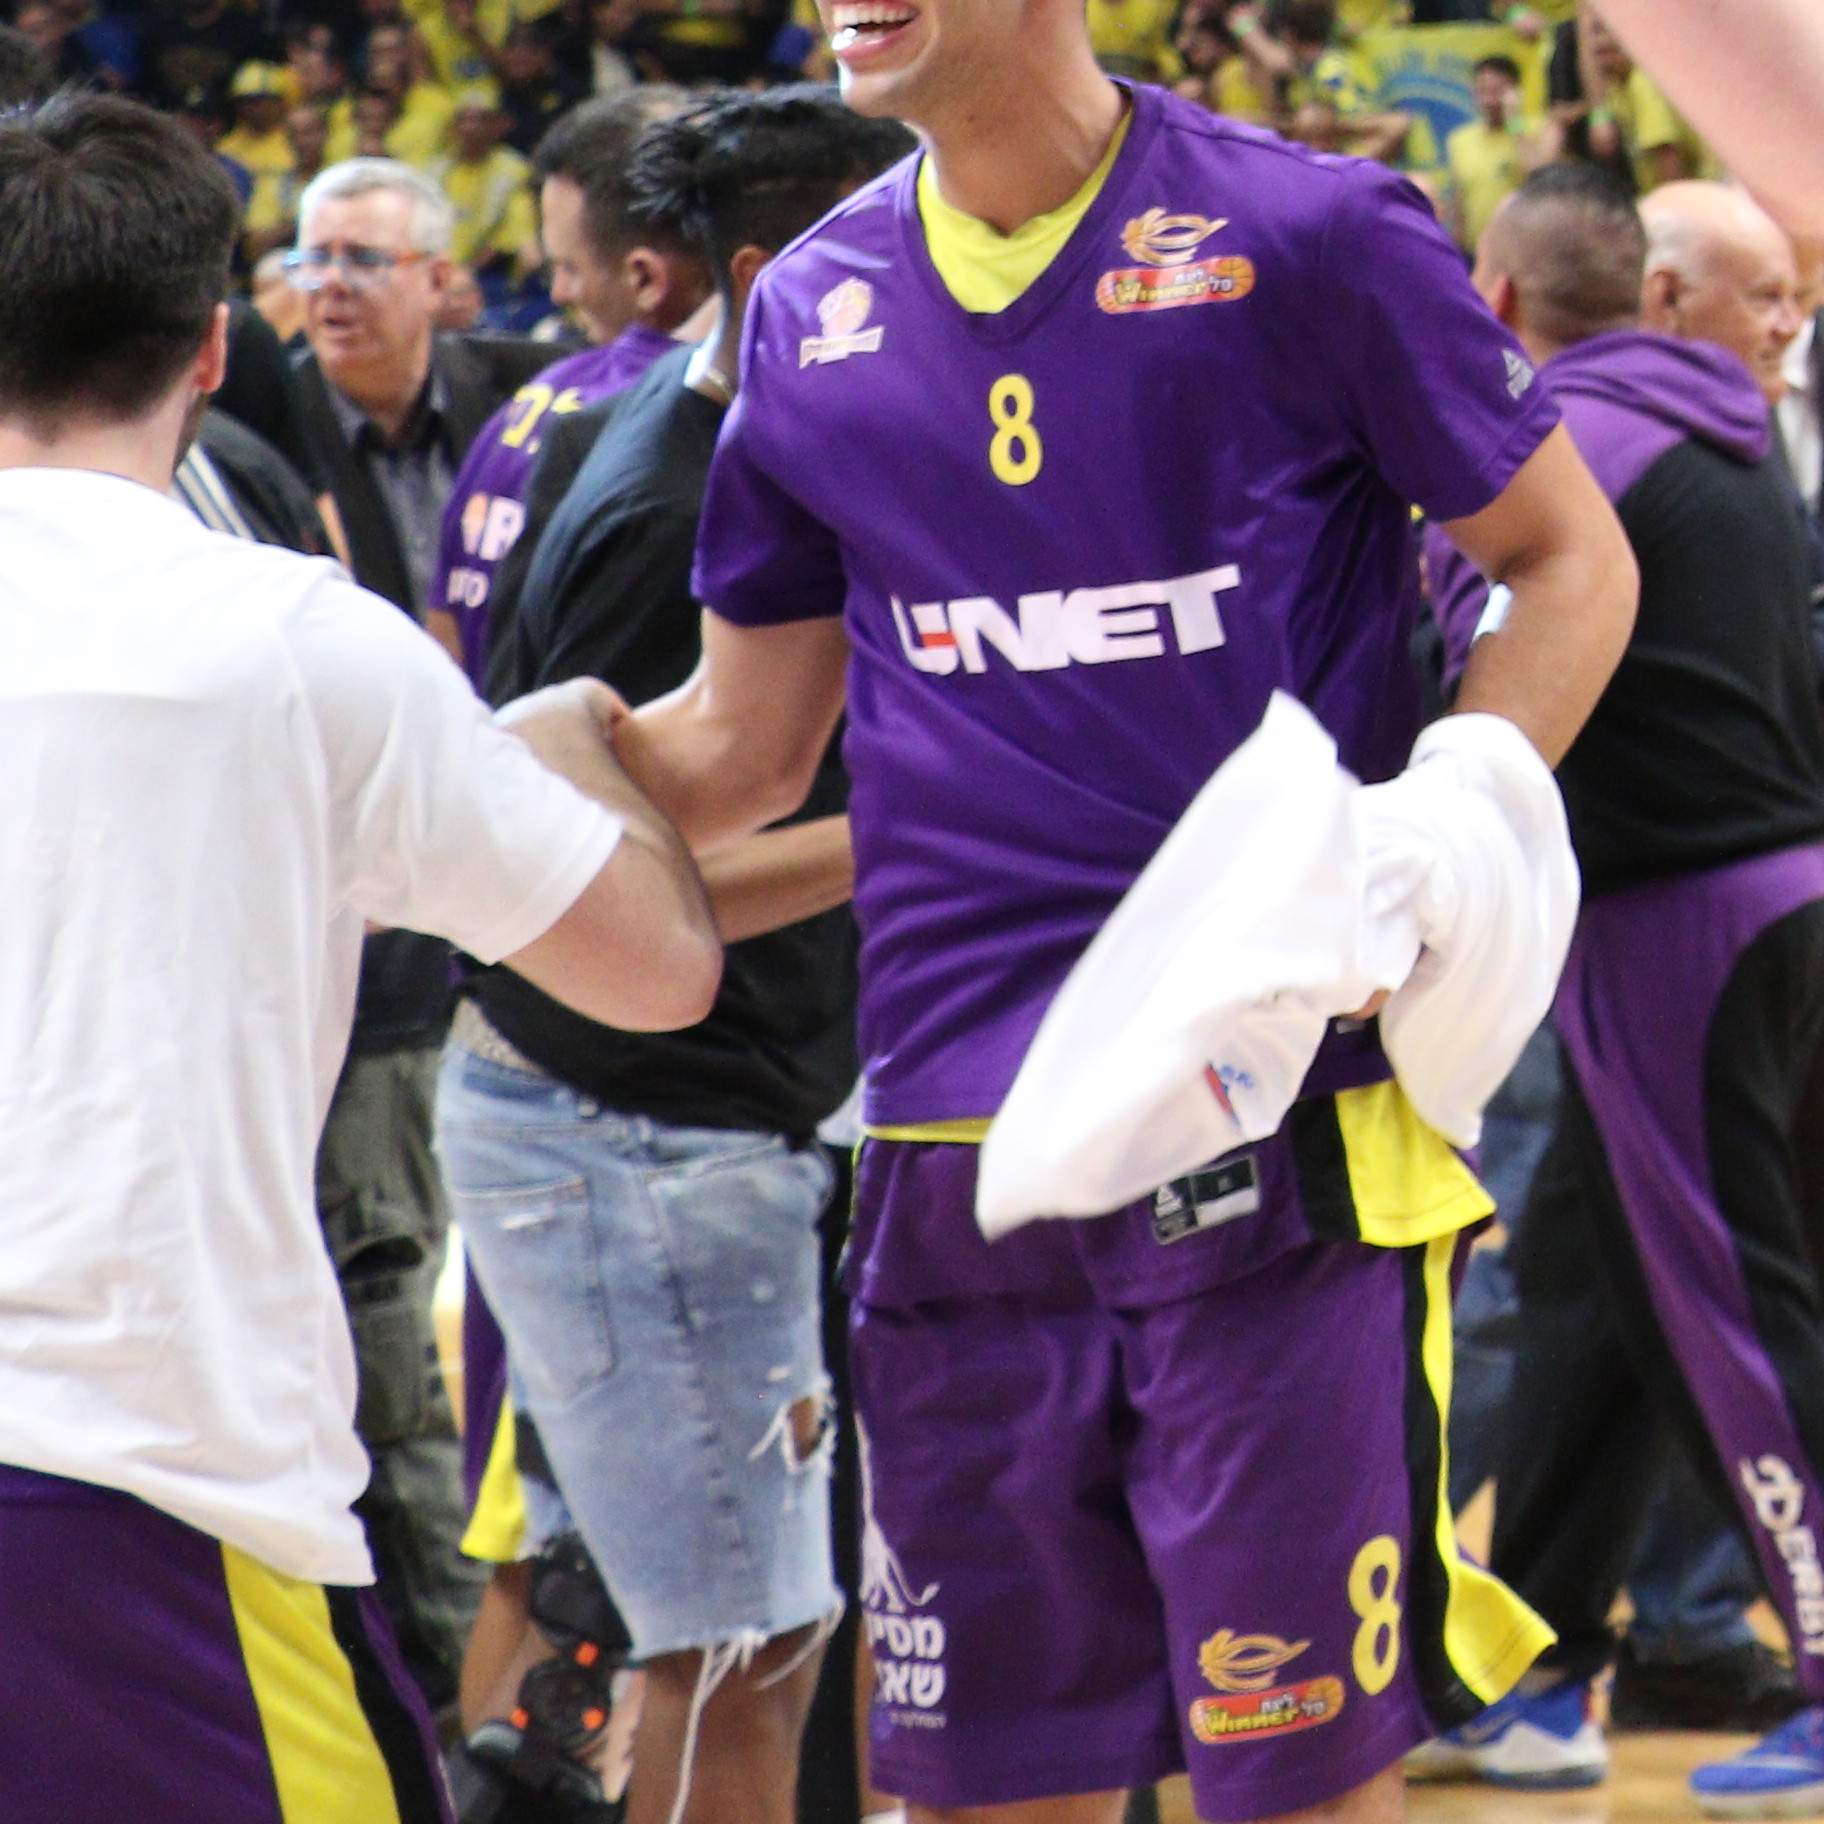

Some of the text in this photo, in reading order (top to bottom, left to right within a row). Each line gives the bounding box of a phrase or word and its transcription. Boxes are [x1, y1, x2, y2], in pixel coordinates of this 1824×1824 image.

[987, 372, 1044, 487] 8
[889, 564, 1241, 677] UNET
[1347, 1533, 1403, 1697] 8
